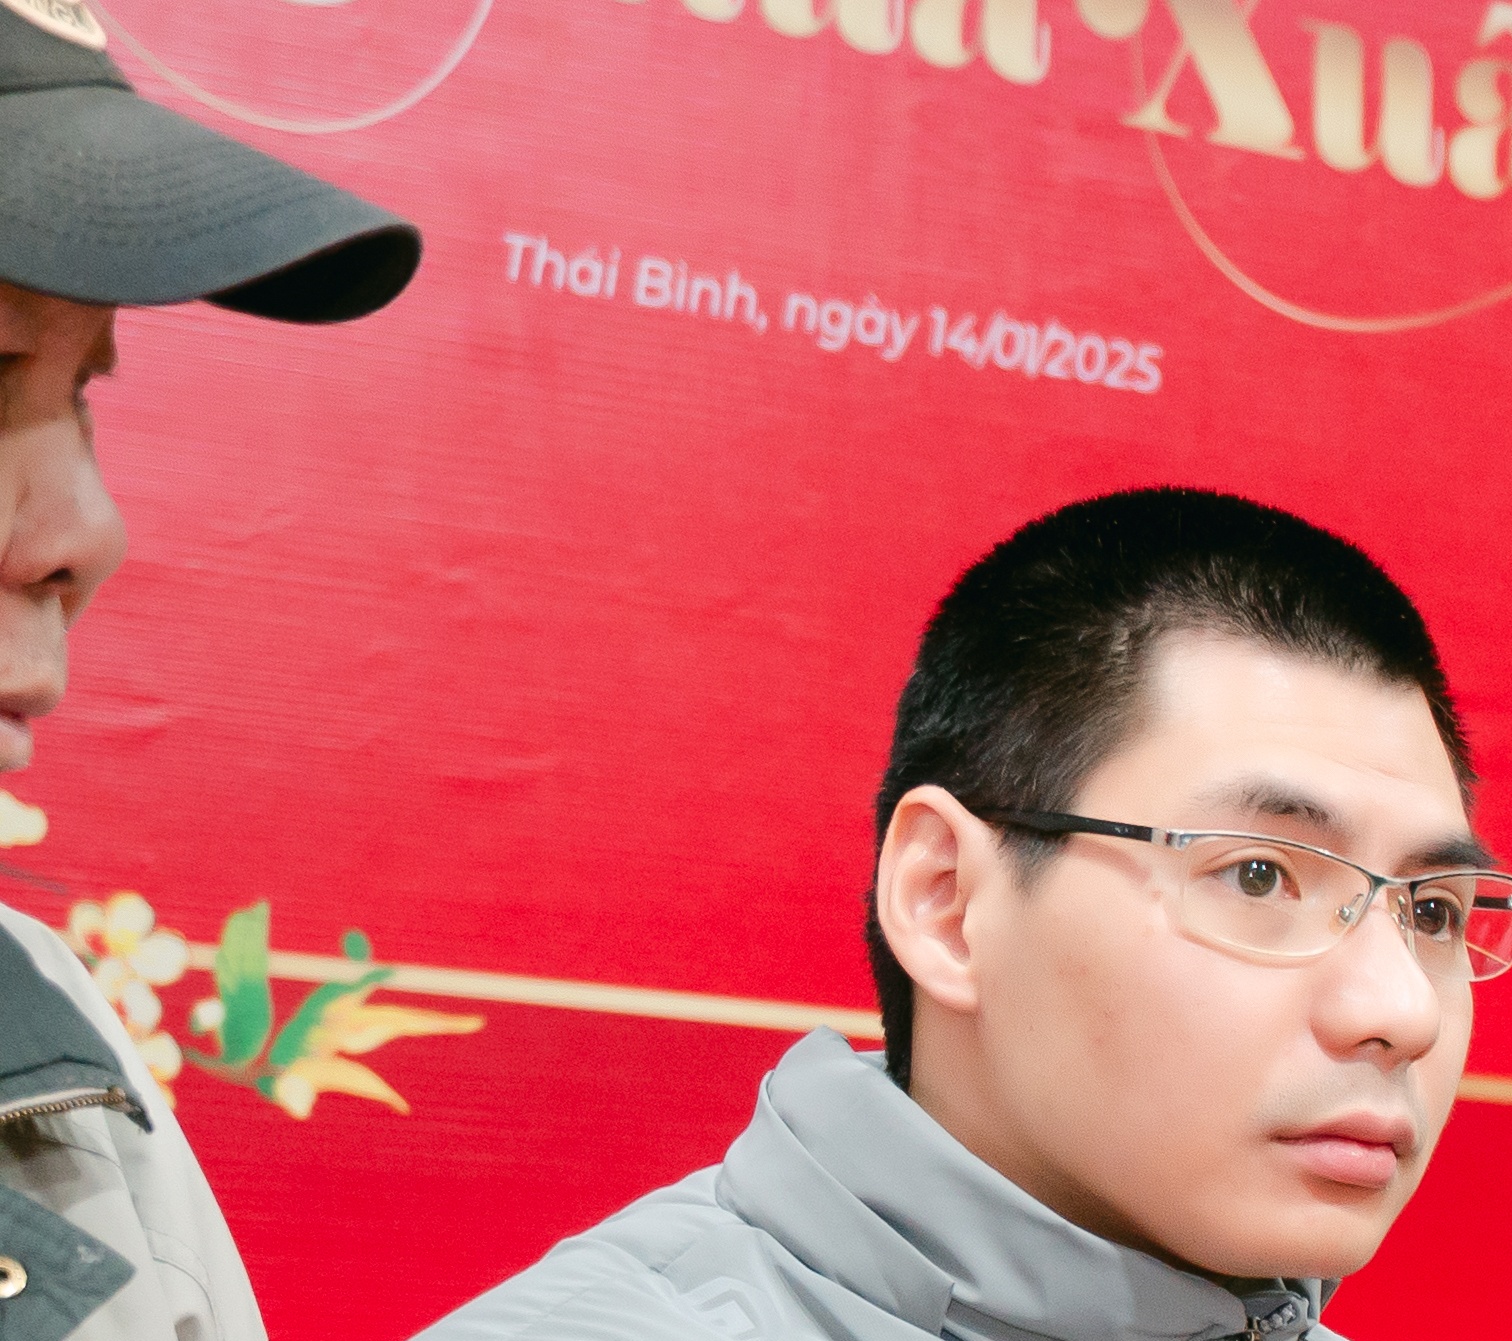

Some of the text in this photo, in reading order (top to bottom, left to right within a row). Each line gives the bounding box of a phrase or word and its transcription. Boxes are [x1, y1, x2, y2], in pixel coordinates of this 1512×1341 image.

[502, 229, 1164, 395] Thái Bình, ngày 14/01/2025
